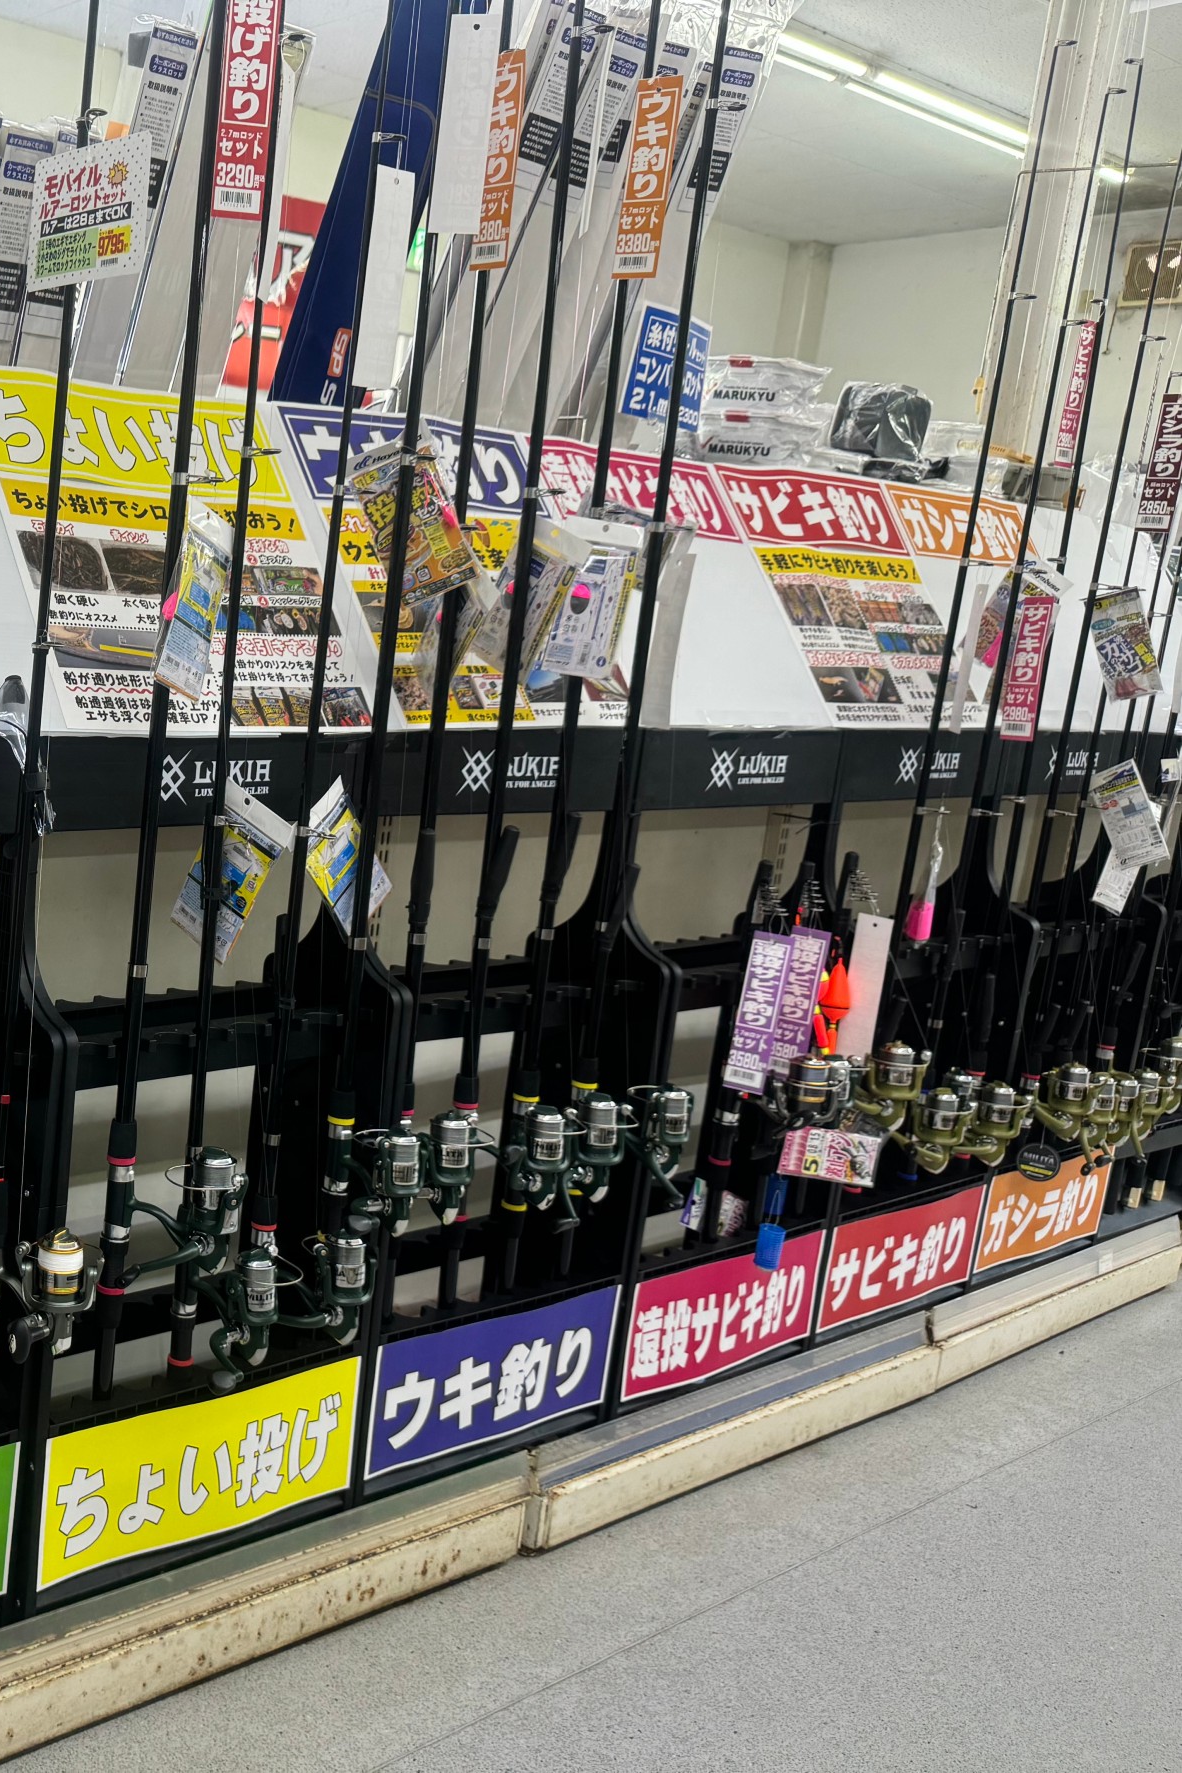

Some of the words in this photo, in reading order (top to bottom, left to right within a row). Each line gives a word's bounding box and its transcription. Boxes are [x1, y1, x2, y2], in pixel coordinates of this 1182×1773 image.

[152, 65, 182, 77] グラスロッド
[154, 58, 184, 70] カーボンロッド
[725, 77, 751, 85] グラスロッド
[726, 71, 753, 80] カーボンロッド
[148, 81, 178, 96] 取扱説明書
[720, 90, 747, 100] 取扱説明書
[220, 128, 263, 140] 2.7mロッド
[9, 138, 48, 150] 必ずお読みください
[219, 138, 263, 160] セット
[630, 90, 671, 198] ウキ釣り
[44, 164, 102, 198] モバイル
[216, 162, 254, 188] 3290
[39, 188, 127, 220] ルアーロッドセット
[621, 204, 659, 216] 2.7mロッド
[43, 204, 128, 234] ルアーは28gまでOK
[620, 212, 659, 230] セット
[98, 233, 124, 257] 9795
[617, 232, 650, 252] 3380
[332, 334, 349, 374] SP
[1065, 327, 1094, 408] サビキ釣り
[713, 389, 776, 402] MARUKYU
[678, 406, 698, 426] 2300
[1061, 417, 1077, 430] セット
[707, 443, 771, 457] MARUKYU
[1144, 487, 1175, 499] セット
[727, 479, 891, 545] サビキ釣り
[1139, 500, 1167, 514] 2850
[54, 594, 99, 607] 細く硬い
[1013, 607, 1048, 682] サビキ釣り
[1005, 692, 1034, 705] セット
[1003, 706, 1027, 720] 2980
[737, 752, 789, 776] LUKIA
[195, 788, 213, 797] LUX
[732, 1036, 767, 1052] セット
[728, 1050, 759, 1070] 3580
[805, 1158, 818, 1173] 5
[982, 1171, 1099, 1258] ガシラ釣り
[829, 1216, 966, 1312] サビキ釣り
[630, 1264, 806, 1381] 遠投サビキ釣り
[383, 1326, 595, 1452] ウキ釣り
[56, 1392, 343, 1560] ちょい投げ
